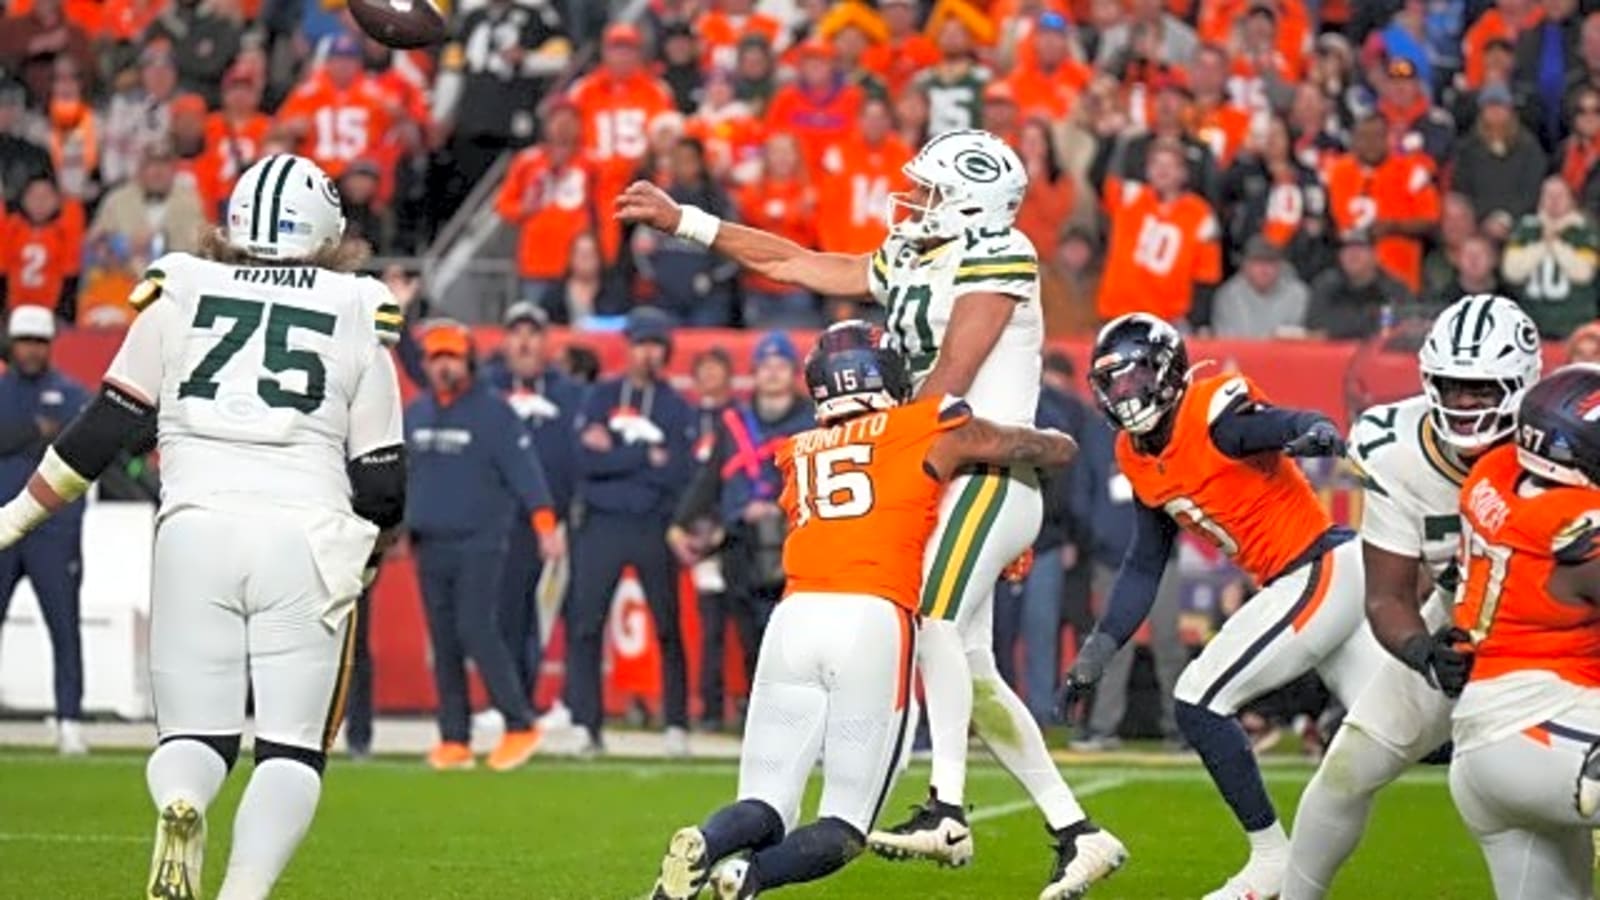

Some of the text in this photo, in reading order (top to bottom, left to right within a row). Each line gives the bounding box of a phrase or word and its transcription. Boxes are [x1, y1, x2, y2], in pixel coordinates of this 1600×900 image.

[315, 105, 369, 161] 15
[595, 107, 648, 160] 15
[21, 242, 47, 288] 2
[178, 295, 337, 415] 75
[833, 369, 858, 391] 15
[1357, 407, 1397, 461] 71
[1522, 425, 1545, 452] 97
[793, 444, 874, 528] 15
